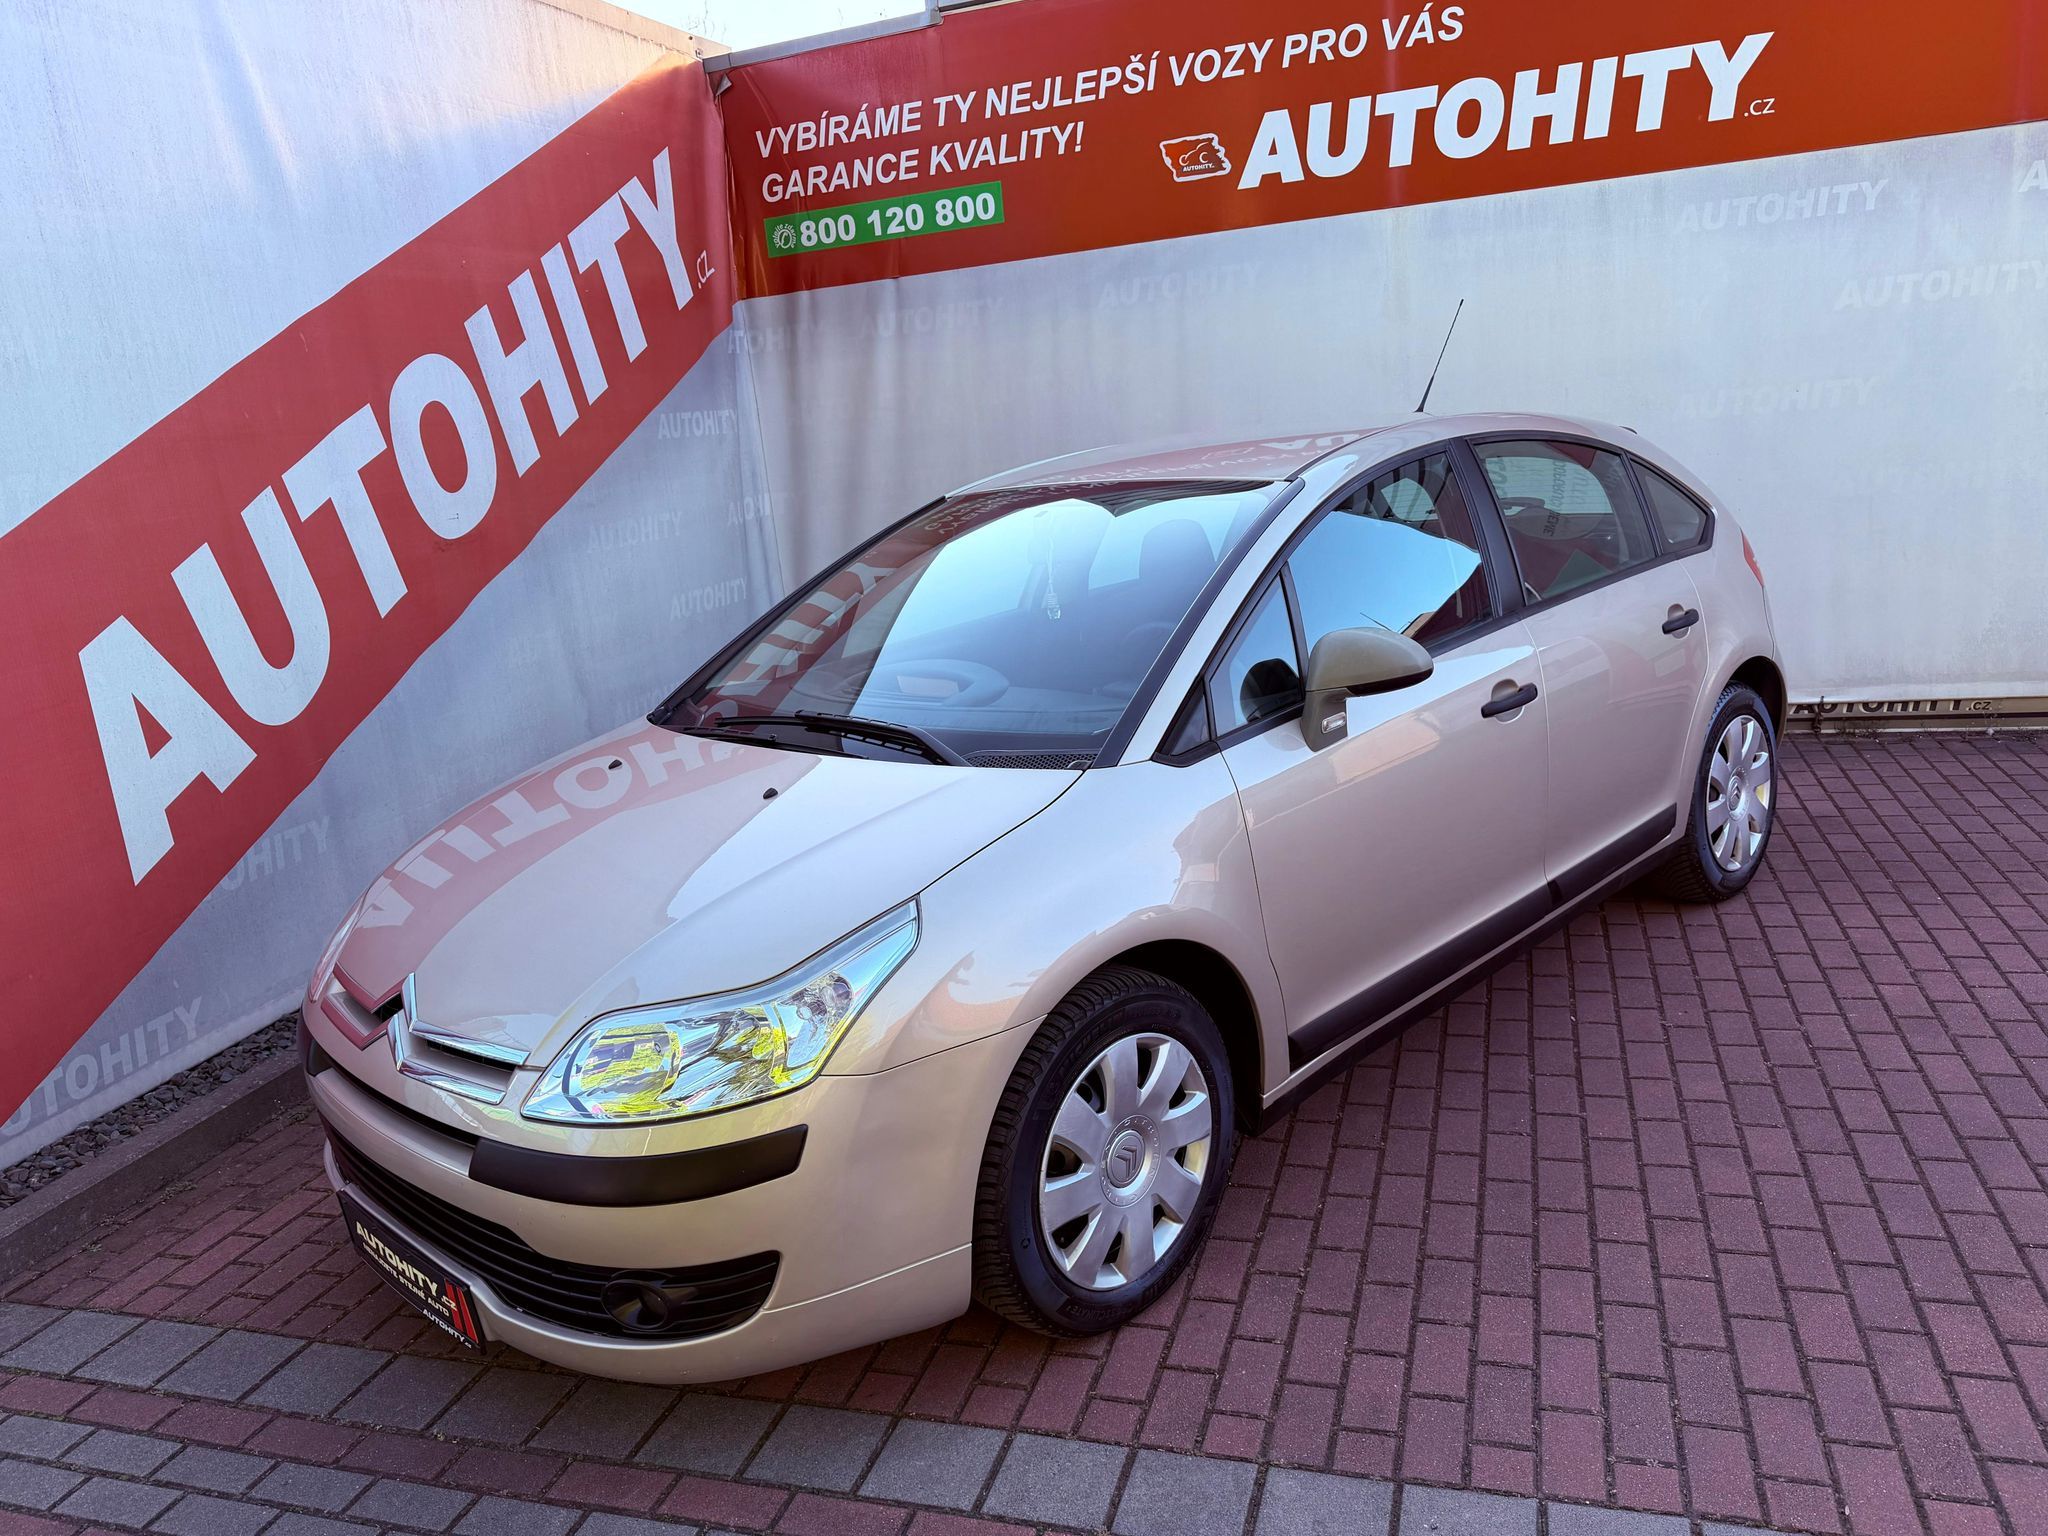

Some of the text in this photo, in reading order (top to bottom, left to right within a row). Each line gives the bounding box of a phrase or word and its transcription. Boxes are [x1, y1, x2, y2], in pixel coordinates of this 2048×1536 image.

[755, 2, 1465, 158] VYBÍRÁME TY NEJLEPŠÍ VOZY PRO VÁS
[1237, 31, 1775, 190] AUTOHITY
[762, 121, 1084, 203] GARANCE KVALITY!
[800, 192, 996, 247] 800 120 800
[1672, 178, 1889, 235] AUTOHITY
[77, 146, 694, 886] AUTOHITY
[356, 1221, 438, 1297] AUTOHITY
[428, 1297, 450, 1317] AUTO
